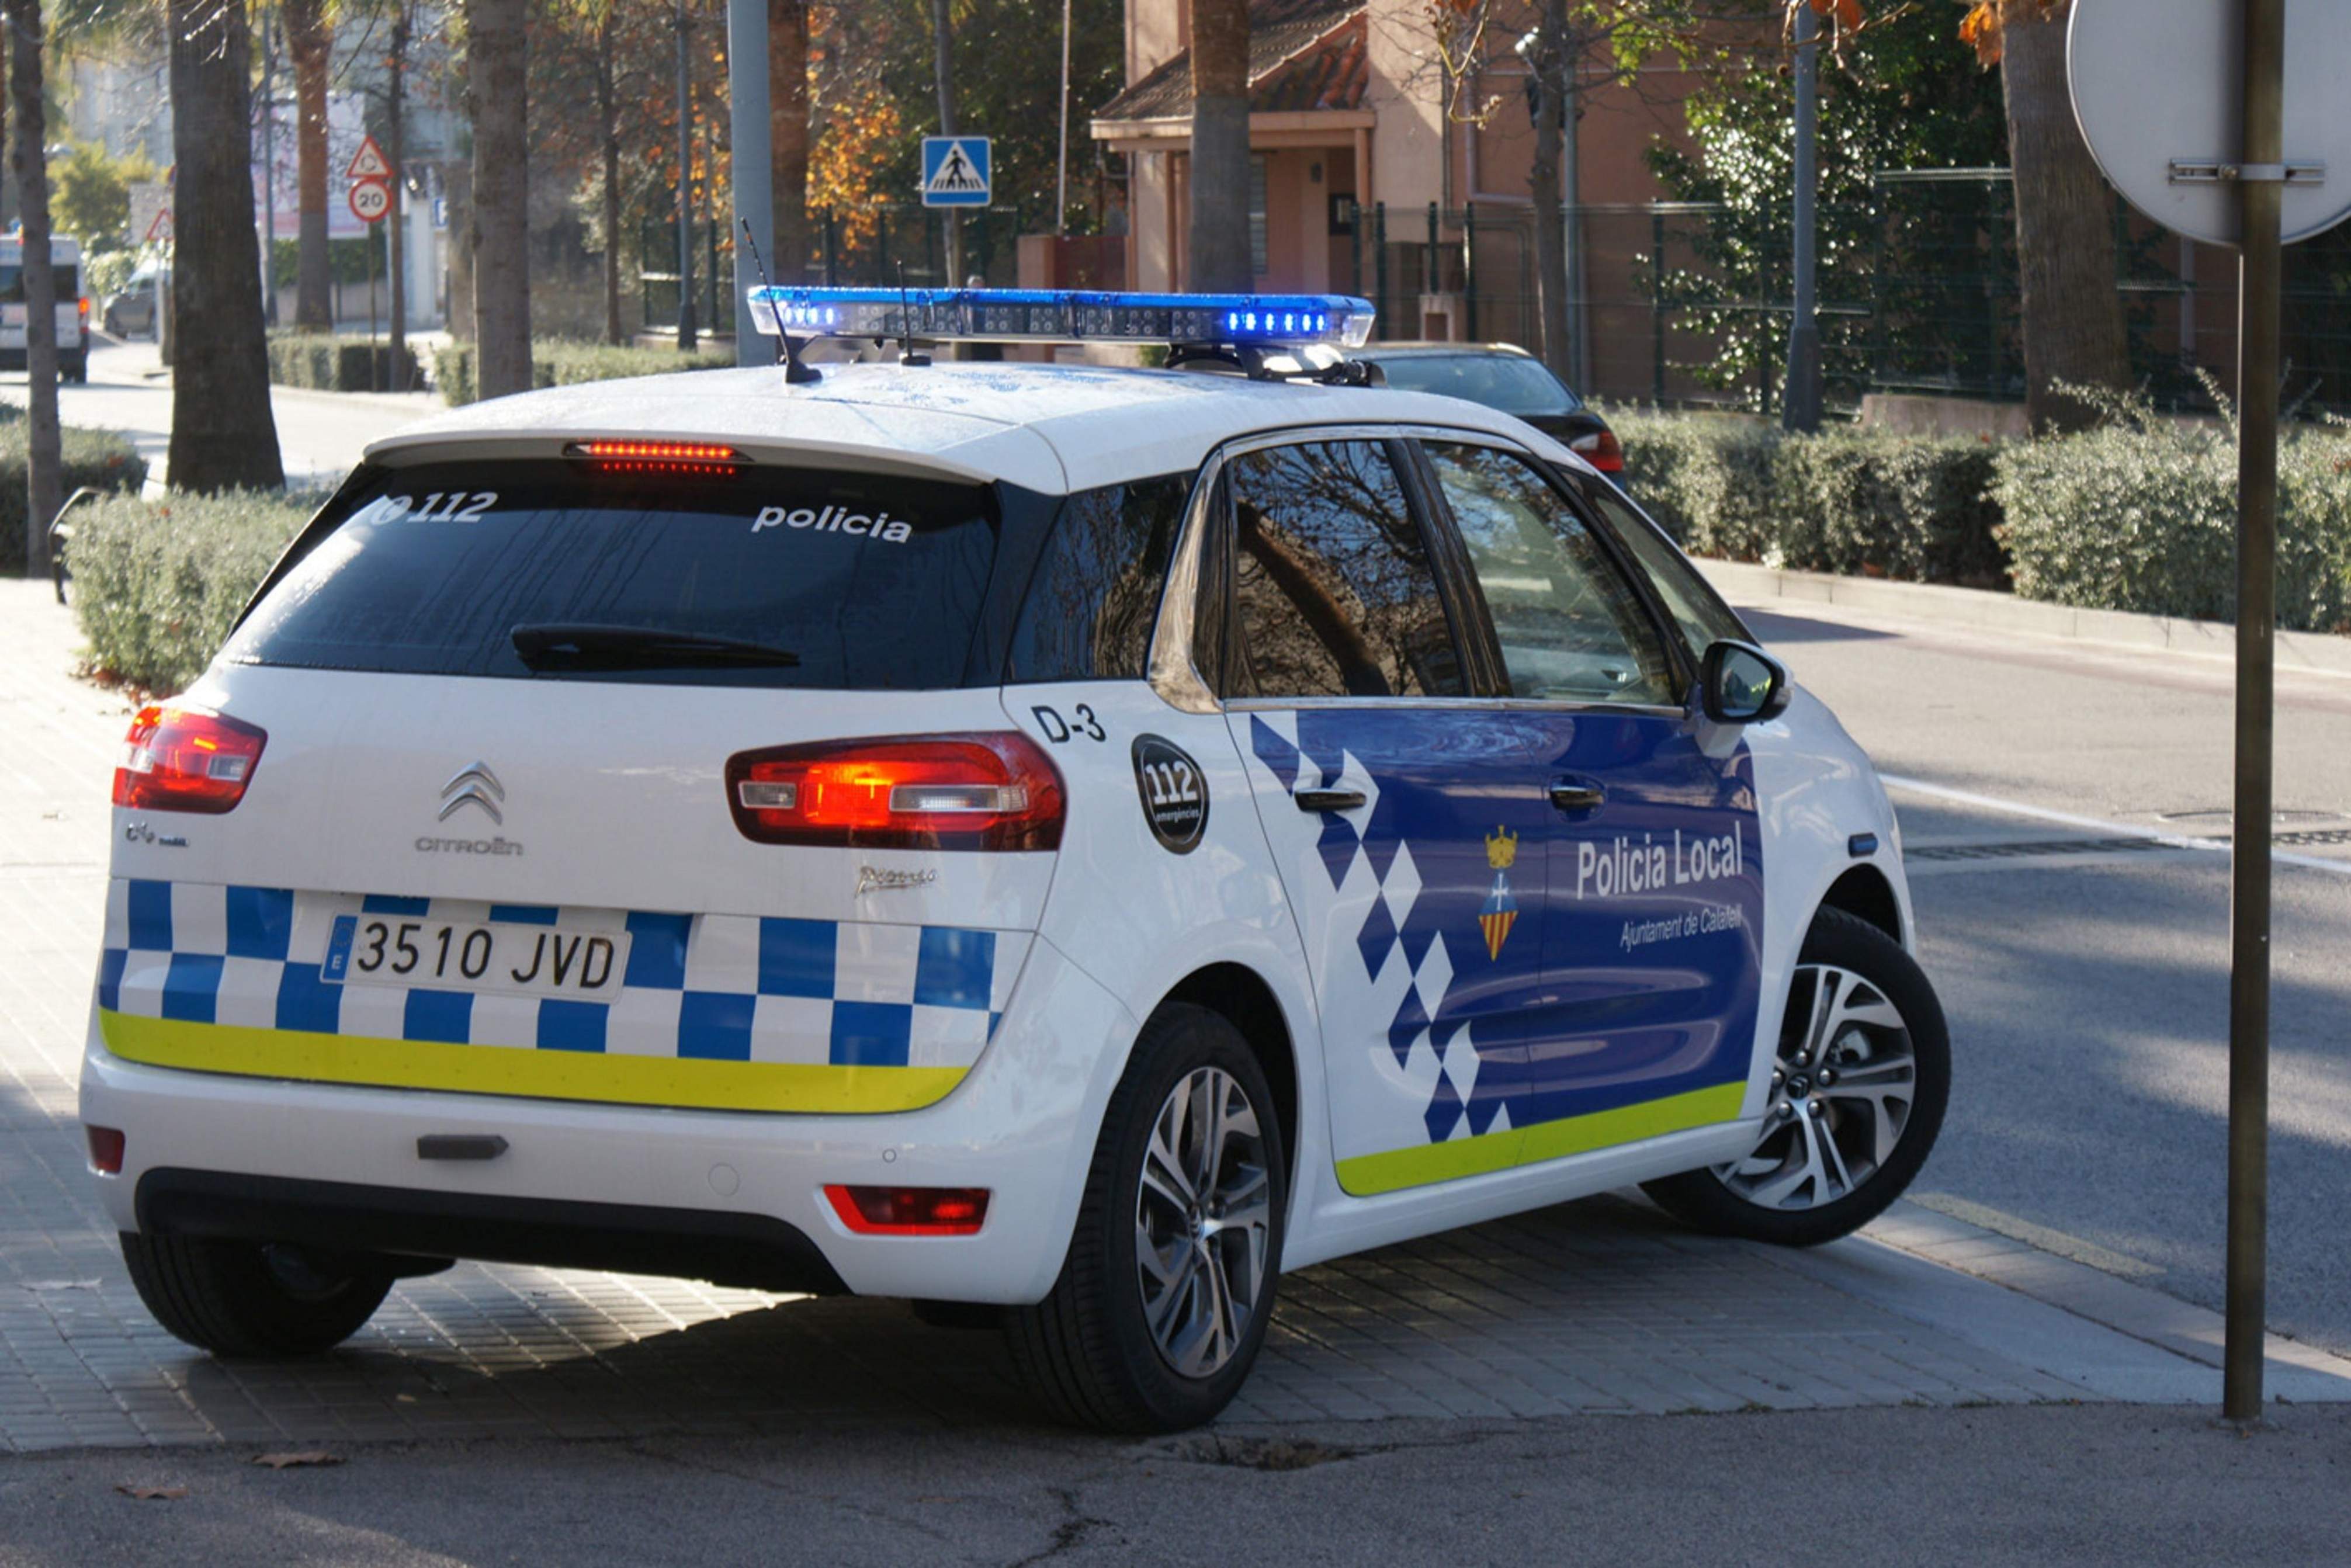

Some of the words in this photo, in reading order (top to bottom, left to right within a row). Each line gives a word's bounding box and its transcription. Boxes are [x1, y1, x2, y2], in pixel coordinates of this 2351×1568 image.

[359, 193, 383, 207] 20
[406, 491, 498, 523] 112
[751, 505, 913, 544] policia
[1031, 703, 1107, 743] D-3
[1145, 761, 1198, 805] 112
[1577, 832, 1667, 900] Policia
[1674, 820, 1743, 884] Local
[1619, 912, 1683, 953] Ajuntament
[1683, 910, 1698, 936] de
[331, 955, 344, 970] E
[357, 921, 493, 979] 3510
[511, 933, 615, 988] JVD
